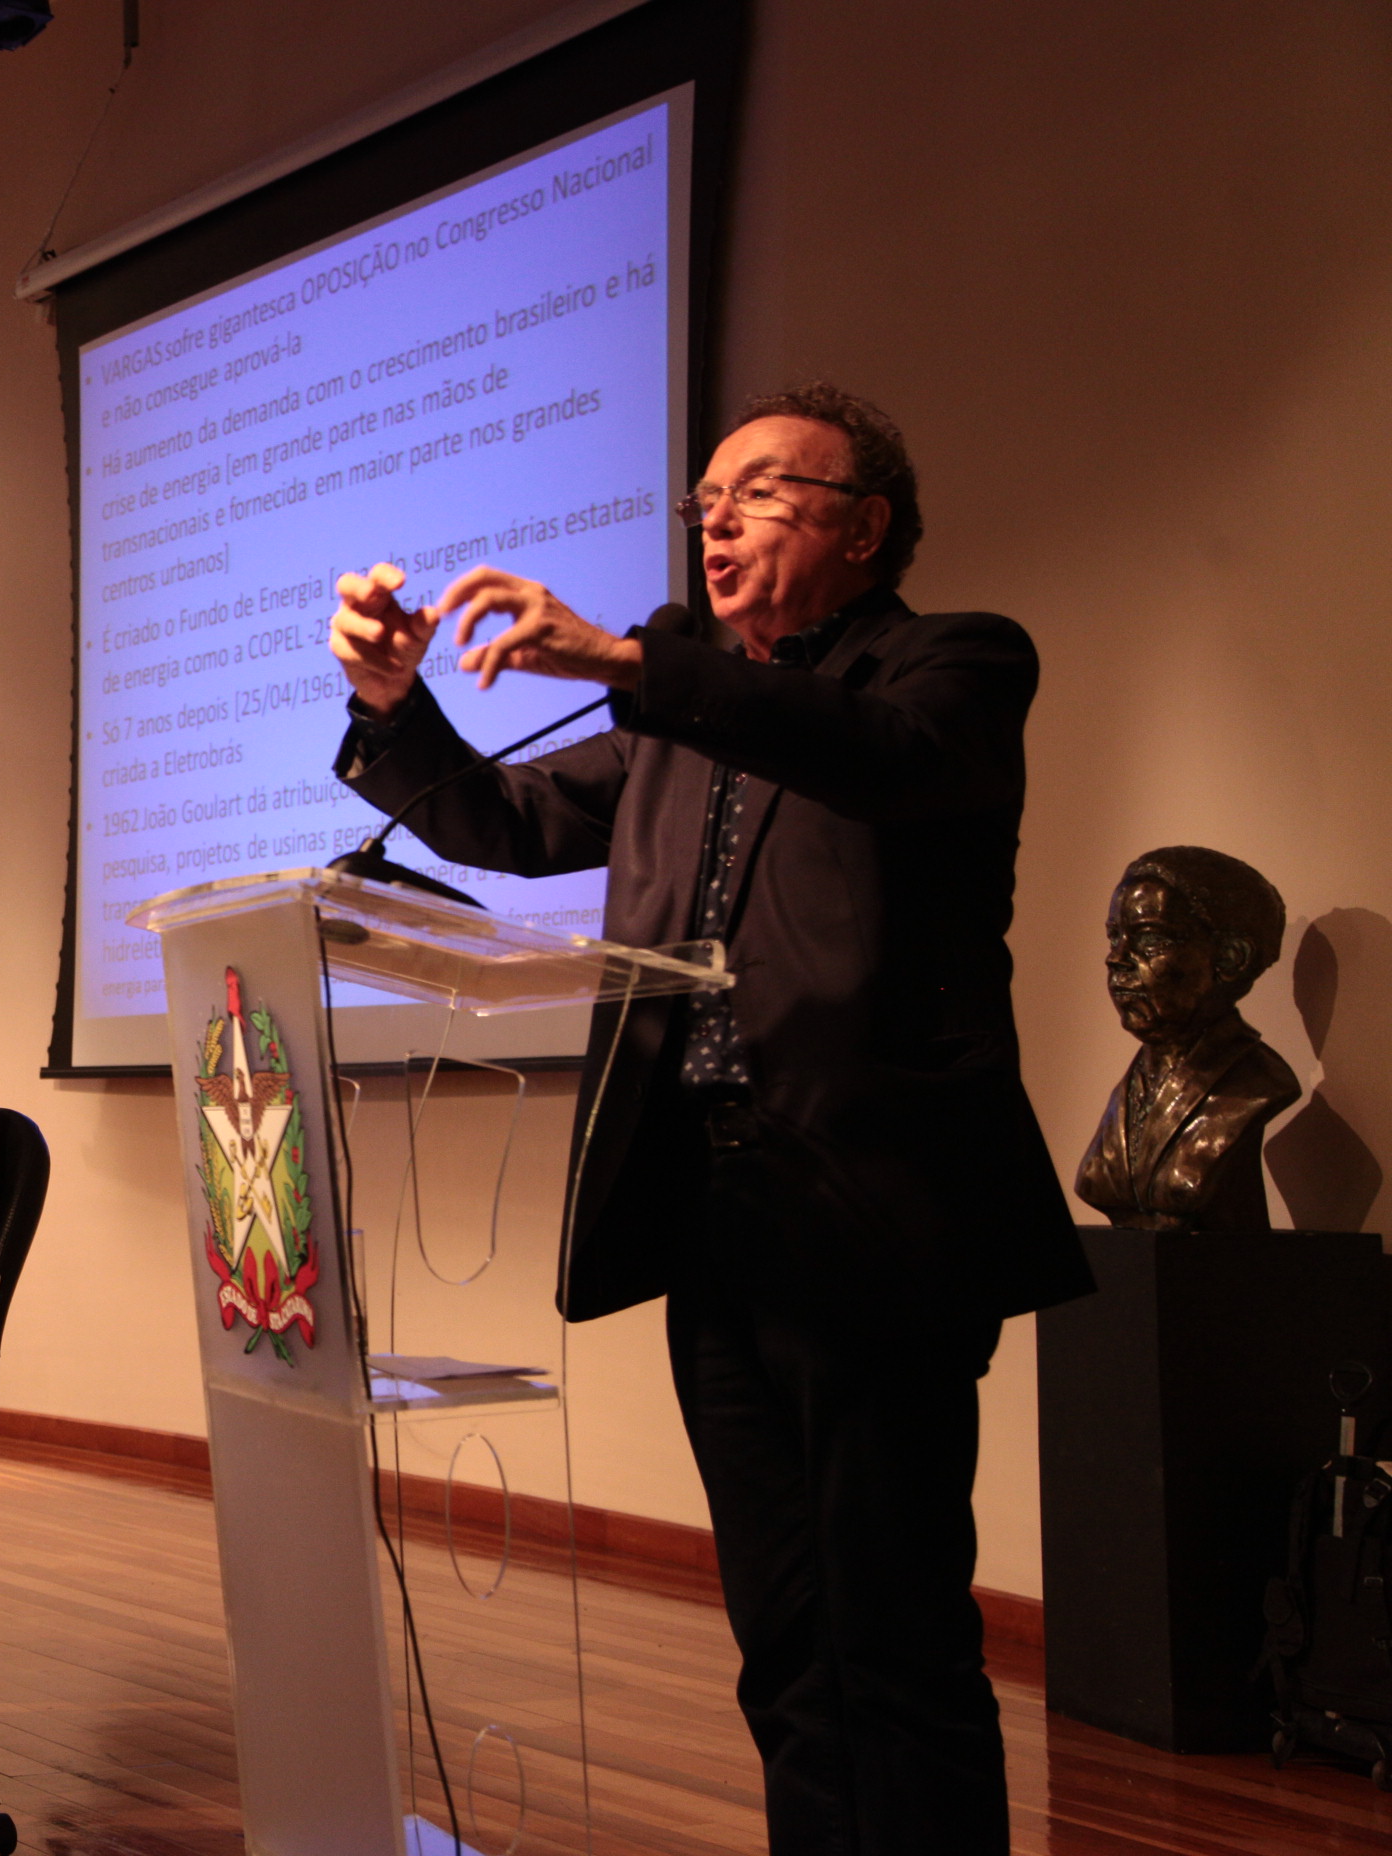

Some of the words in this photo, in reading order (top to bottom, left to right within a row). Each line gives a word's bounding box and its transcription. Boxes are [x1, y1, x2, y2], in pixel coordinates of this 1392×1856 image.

[101, 340, 163, 385] VARGAS
[164, 327, 204, 361] sofre
[208, 290, 296, 349] gigantesca
[300, 241, 400, 304] OPOSIÇÃO
[404, 235, 429, 263] no
[435, 187, 544, 250] Congresso
[552, 132, 654, 203] Nacional
[101, 448, 122, 478] Há
[124, 429, 193, 470] aumento
[198, 417, 218, 444] da
[222, 386, 301, 435] demanda
[306, 375, 344, 405] com
[349, 368, 362, 389] o
[367, 322, 488, 383] crescimento
[495, 283, 596, 338] brasileiro
[605, 274, 620, 299] e
[626, 252, 655, 291] há
[101, 409, 111, 428] e
[114, 394, 142, 422] não
[145, 367, 219, 411] consegue
[223, 331, 302, 383] aprová-la
[101, 492, 136, 520] crise
[139, 482, 159, 508] de
[162, 461, 221, 500] energia
[225, 452, 258, 485] [em
[262, 426, 323, 473] grande
[328, 411, 378, 450] parte
[383, 398, 416, 426] nas
[422, 377, 476, 414] mãos
[482, 363, 509, 394] de
[101, 508, 210, 561] transnacionais
[214, 507, 226, 526] e
[229, 476, 308, 521] fornecida
[315, 470, 343, 495] em
[349, 450, 404, 482] maior
[410, 432, 463, 472] parte
[469, 418, 506, 448] nos
[512, 387, 601, 443] grandes
[102, 570, 157, 603] centros
[160, 541, 229, 586] urbanos]
[114, 617, 161, 650] criado
[164, 617, 175, 637] o
[179, 599, 229, 632] Fundo
[234, 593, 254, 618] de
[259, 576, 323, 612] Energia
[414, 535, 489, 573] surgem
[494, 515, 559, 551] várias
[564, 487, 654, 535] estatais
[102, 669, 121, 694] de
[123, 655, 180, 689] energia
[184, 647, 228, 675] como
[234, 644, 244, 663] a
[248, 625, 303, 659] COPEL
[101, 718, 120, 745] Só
[123, 715, 133, 740] 7
[136, 713, 173, 738] anos
[177, 697, 229, 731] depois
[102, 757, 148, 788] criada
[150, 759, 160, 778] a
[164, 739, 243, 777] Eletrobrás
[103, 807, 138, 837] 1962
[141, 803, 177, 831] João
[181, 794, 242, 824] Goulart
[248, 788, 268, 813] dá
[102, 853, 170, 884] pesquisa,
[176, 843, 240, 873] projetos
[248, 838, 268, 859] de
[273, 831, 326, 856] usinas
[143, 973, 165, 997] par
